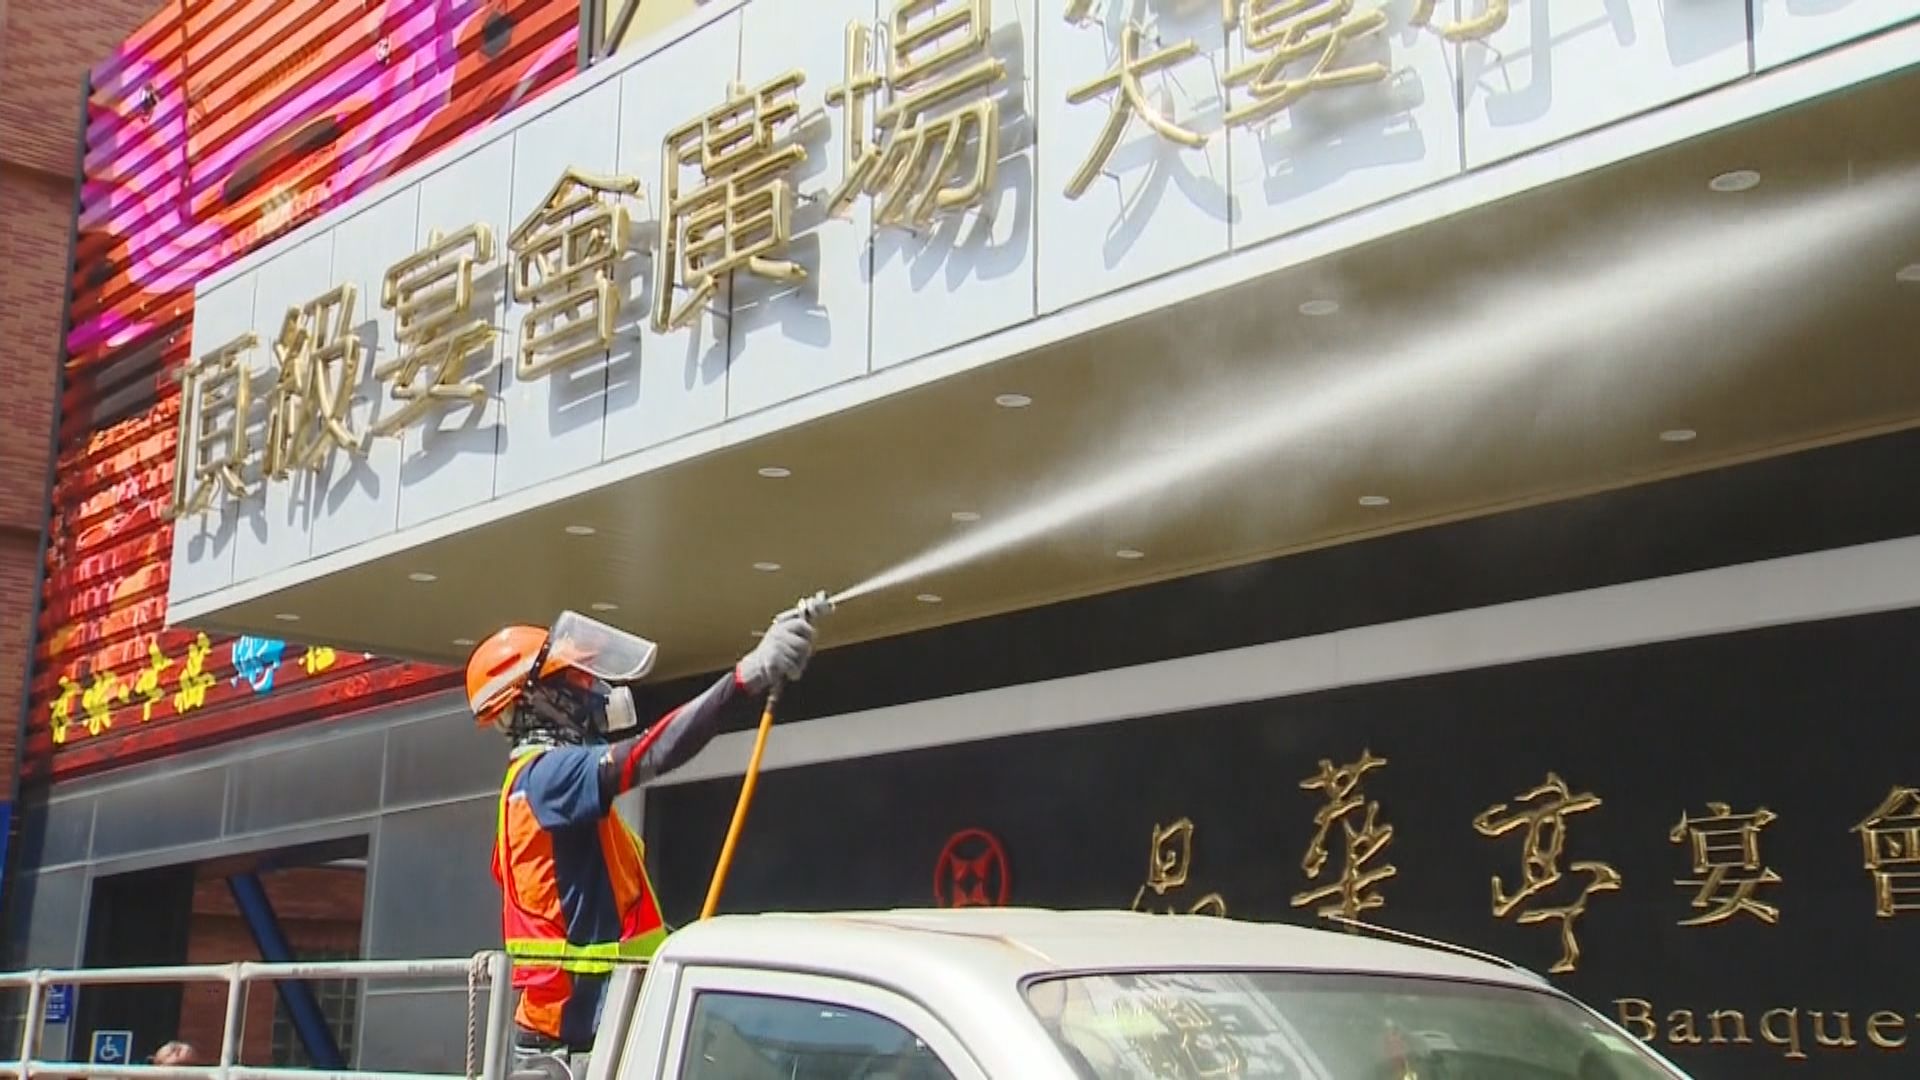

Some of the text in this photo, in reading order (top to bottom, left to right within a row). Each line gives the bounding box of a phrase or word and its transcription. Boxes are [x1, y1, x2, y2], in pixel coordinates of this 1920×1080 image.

[162, 0, 1006, 520] 頂級宴會廣場
[1613, 997, 1920, 1059] Banque
